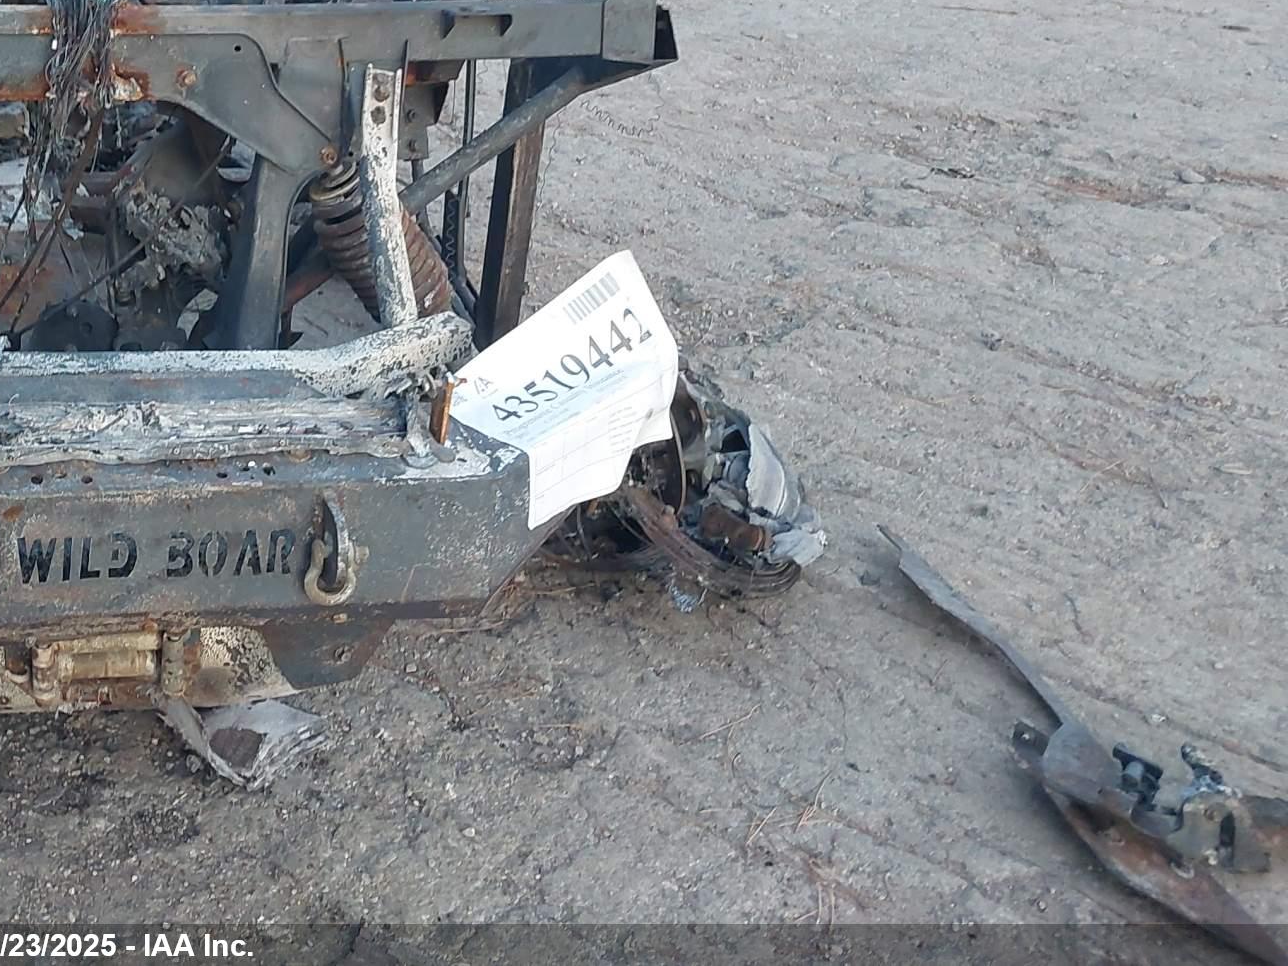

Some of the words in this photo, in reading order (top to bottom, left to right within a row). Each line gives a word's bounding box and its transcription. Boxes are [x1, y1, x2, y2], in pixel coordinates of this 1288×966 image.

[491, 307, 653, 423] 43519442
[17, 533, 138, 584] WILD
[166, 528, 296, 578] BOAR
